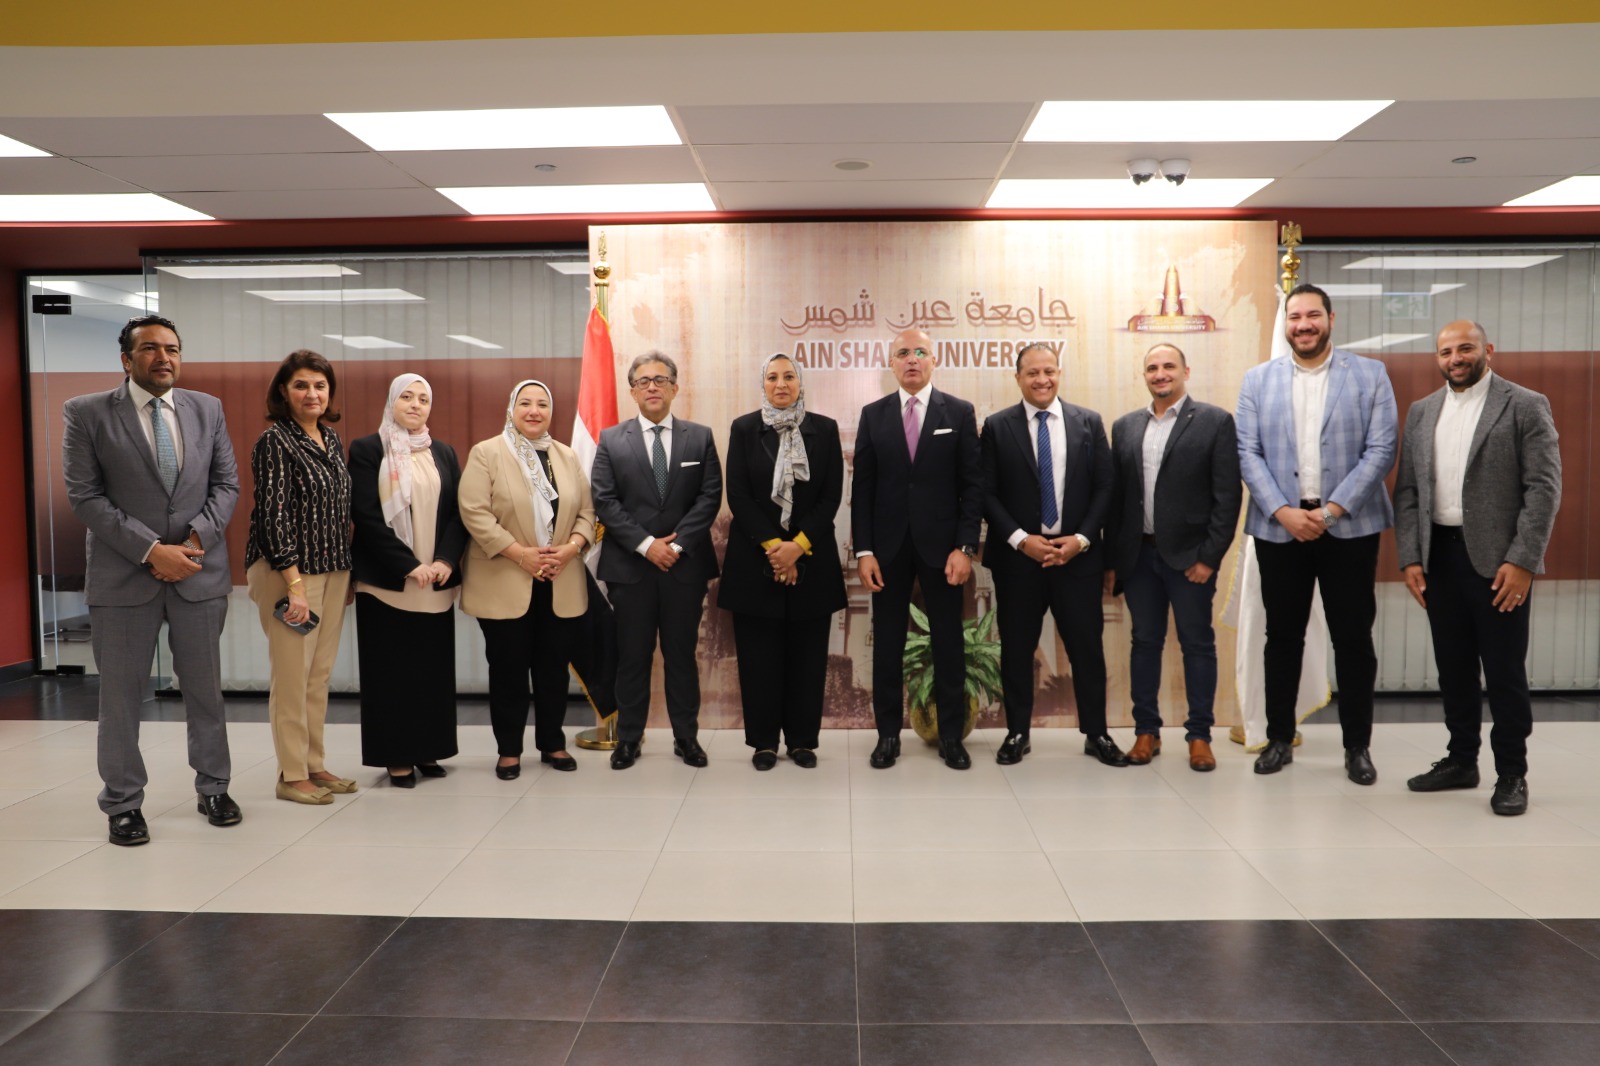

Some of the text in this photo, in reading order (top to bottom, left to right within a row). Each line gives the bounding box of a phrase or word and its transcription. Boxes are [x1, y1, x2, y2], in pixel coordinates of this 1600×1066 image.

[780, 285, 1076, 330] جامعة عين شمس
[794, 340, 1065, 369] AIN SHA NIVERY
